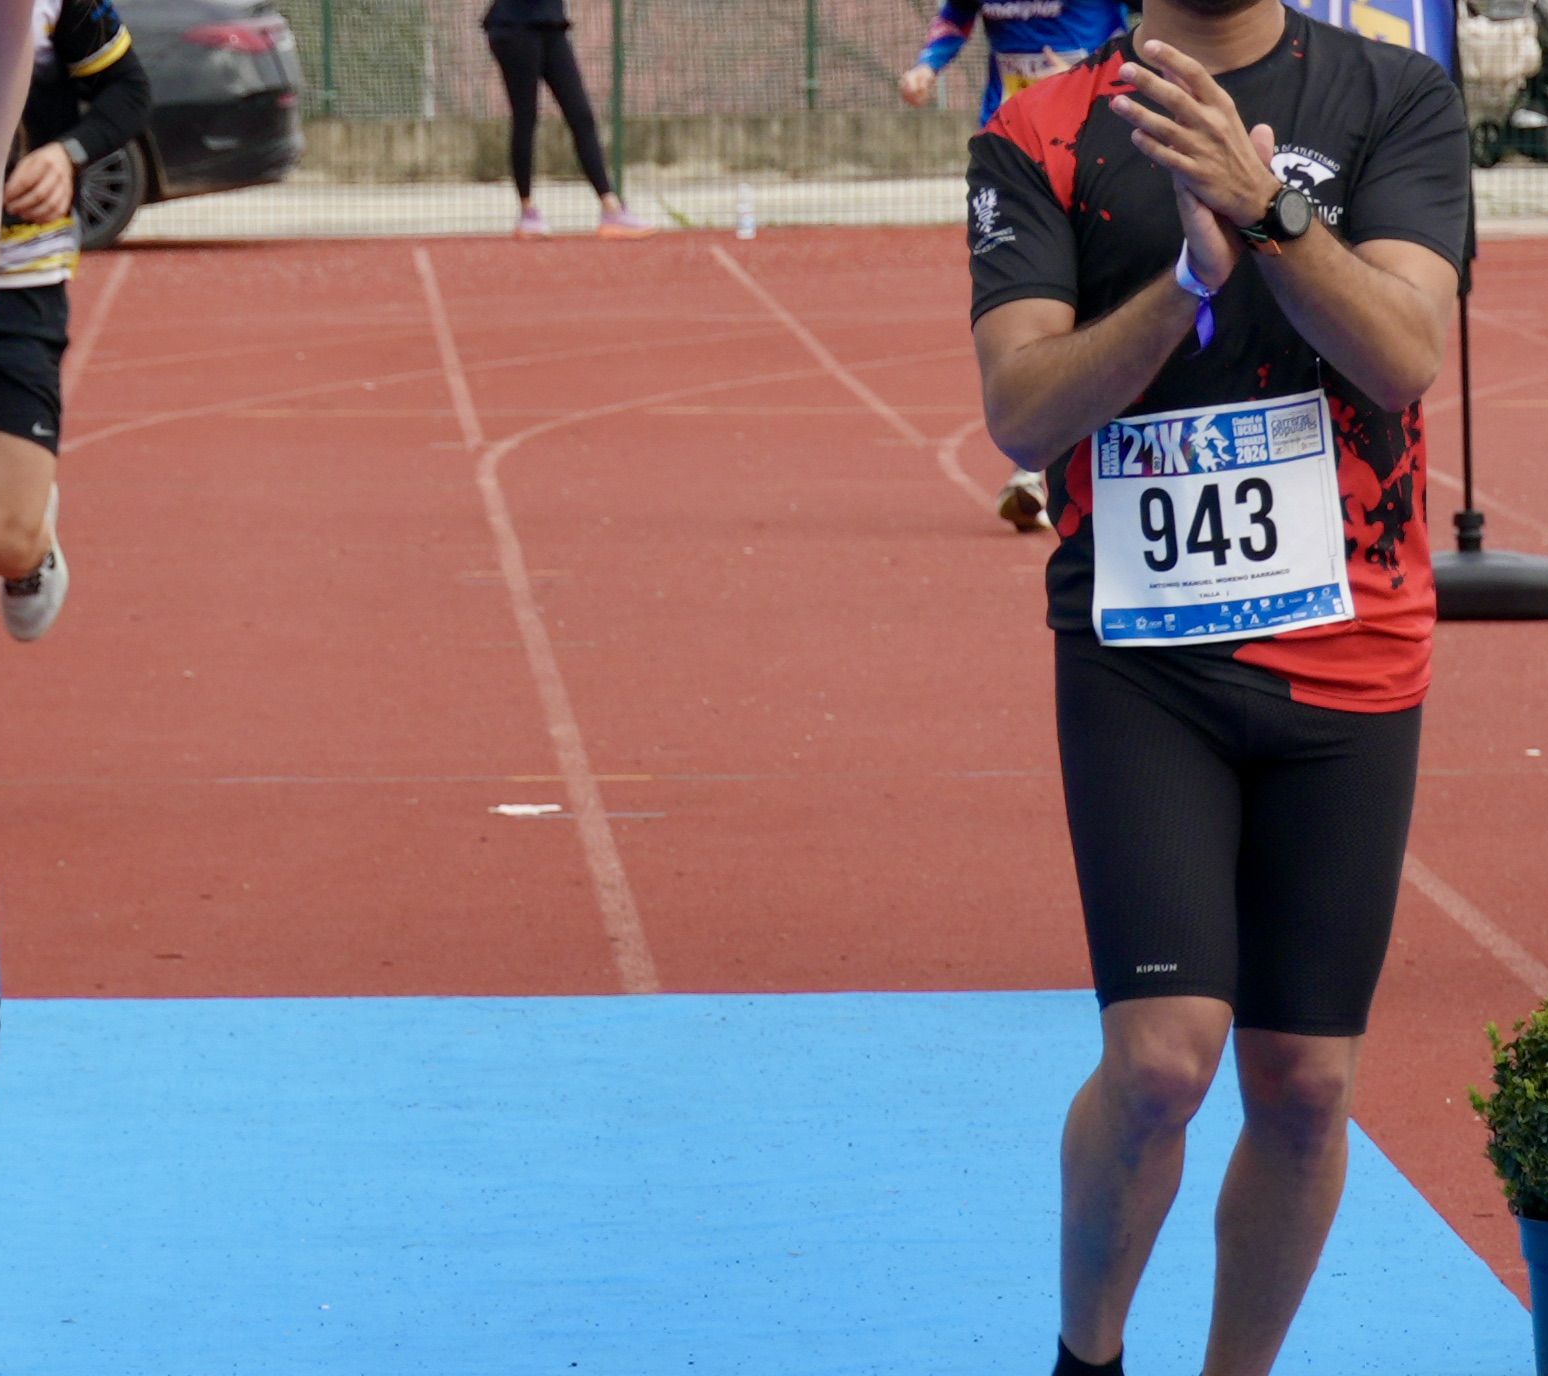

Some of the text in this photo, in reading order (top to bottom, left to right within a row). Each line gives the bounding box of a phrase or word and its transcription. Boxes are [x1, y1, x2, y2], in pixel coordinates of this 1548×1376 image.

[1293, 146, 1341, 172] ATLETISMO
[1236, 444, 1268, 465] 2026
[1138, 476, 1279, 573] 943
[1136, 963, 1177, 973] KIPRUN
